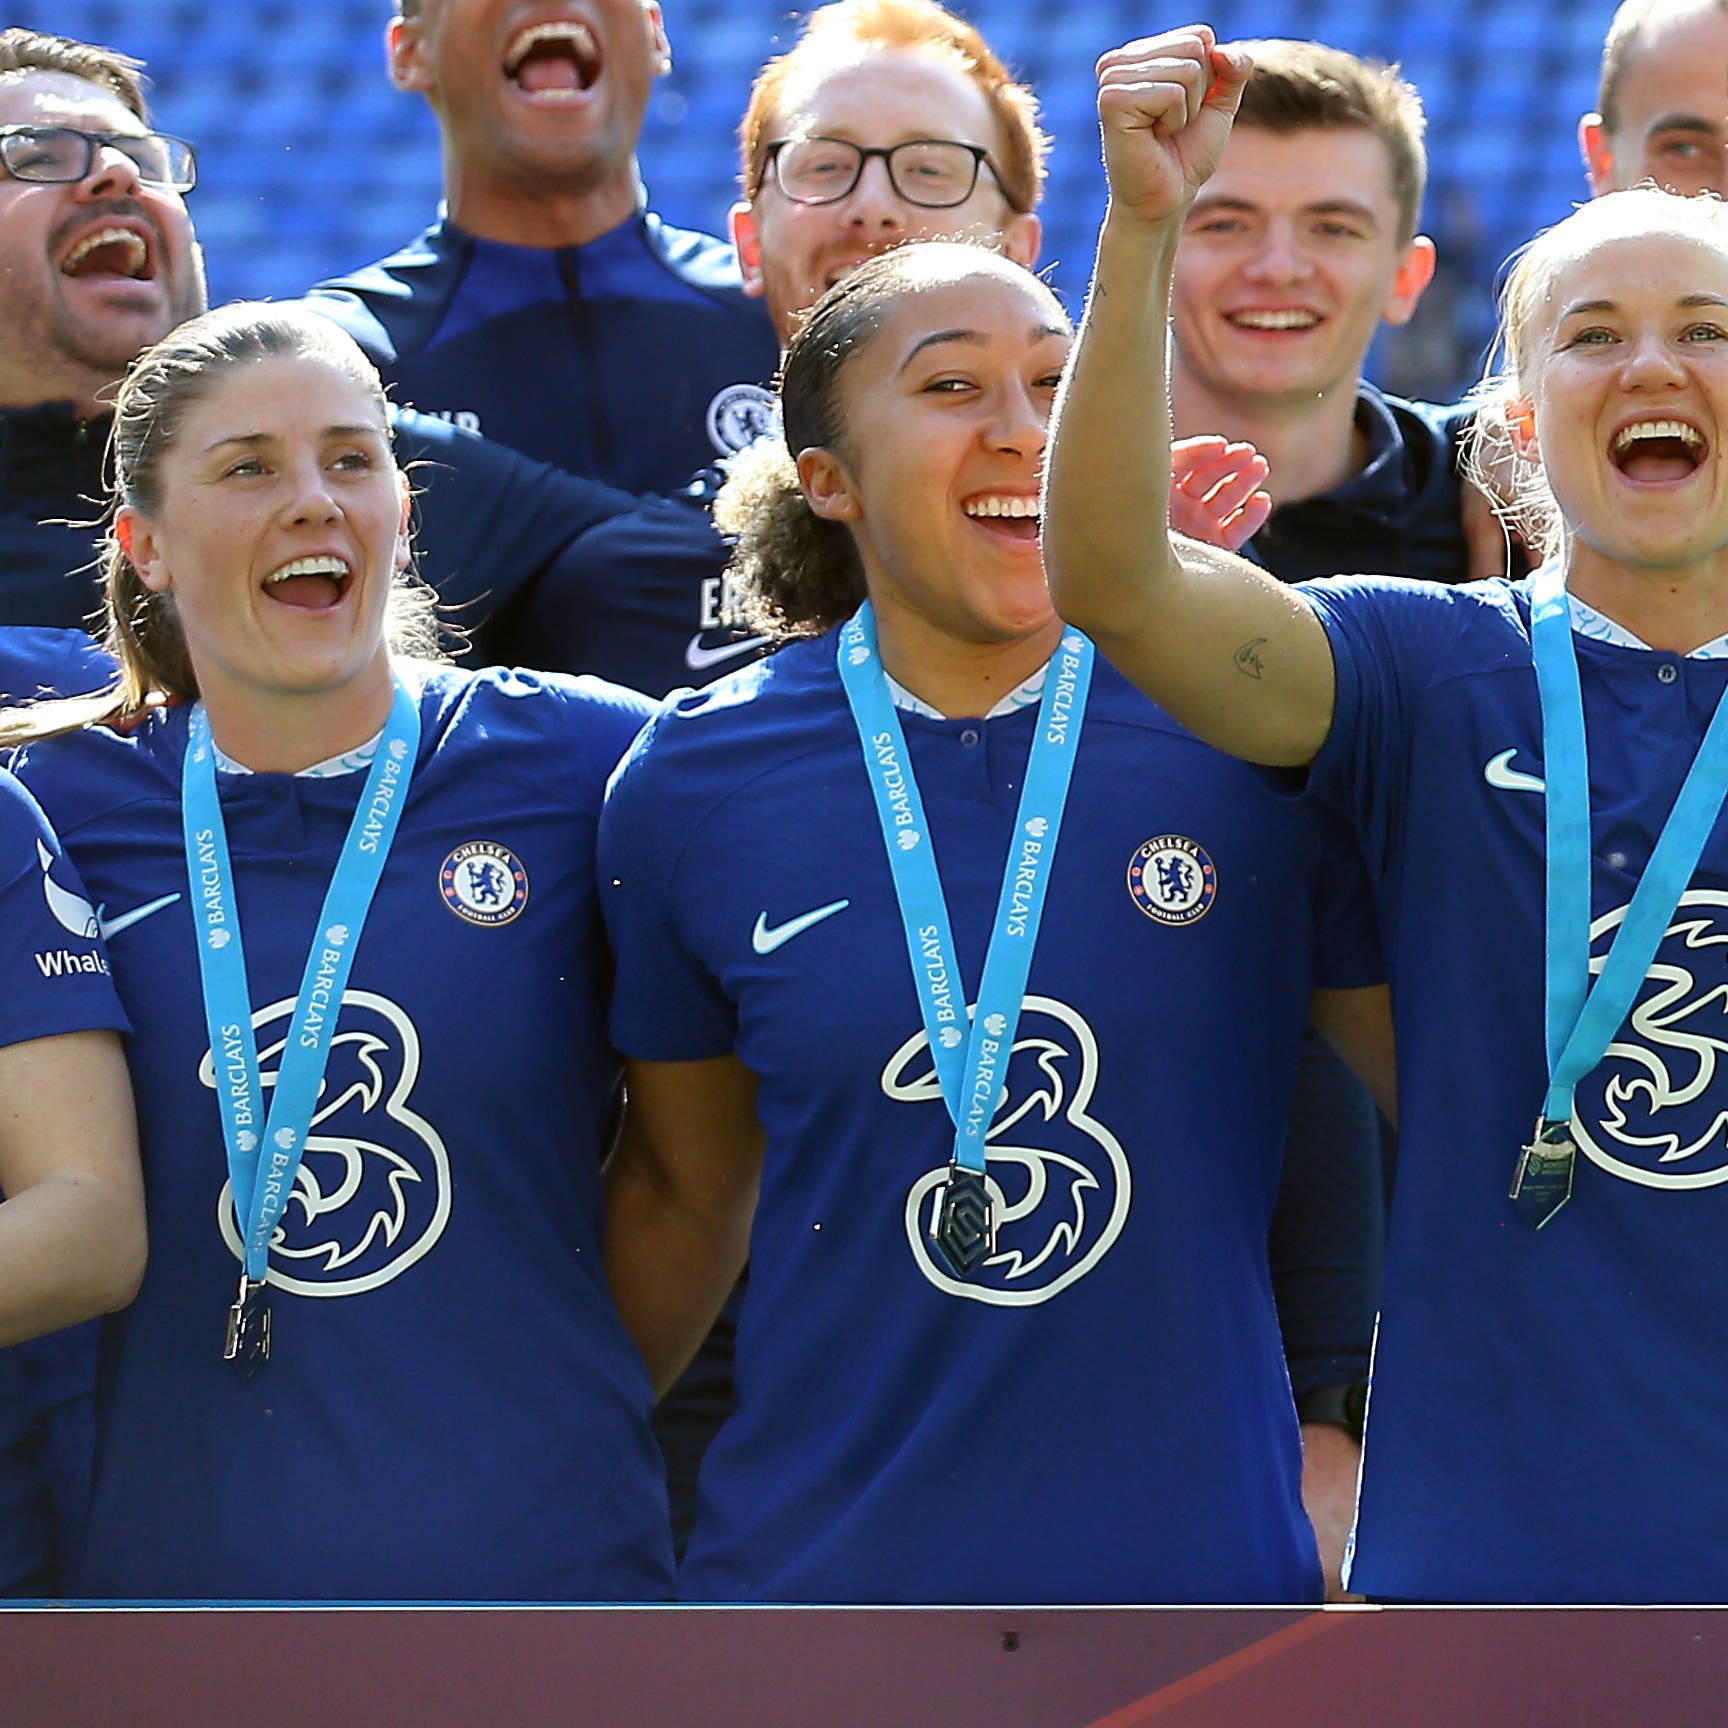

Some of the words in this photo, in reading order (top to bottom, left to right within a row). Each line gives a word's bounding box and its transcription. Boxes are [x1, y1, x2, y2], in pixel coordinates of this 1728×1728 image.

[1047, 654, 1081, 745] BARCLAYS
[359, 759, 403, 854] BARCLAYS
[873, 732, 915, 826] BARCLAYS
[196, 828, 226, 924] BARCLAYS
[453, 844, 512, 864] CHELSEA
[1007, 841, 1042, 937] BARCLAYS
[1141, 838, 1199, 857] CHELSEA
[300, 948, 342, 1049] BARCLAYS
[919, 925, 958, 1023] BARCLAYS
[222, 1023, 254, 1125] BARCLAYS
[966, 1039, 1000, 1137] BARCLAYS
